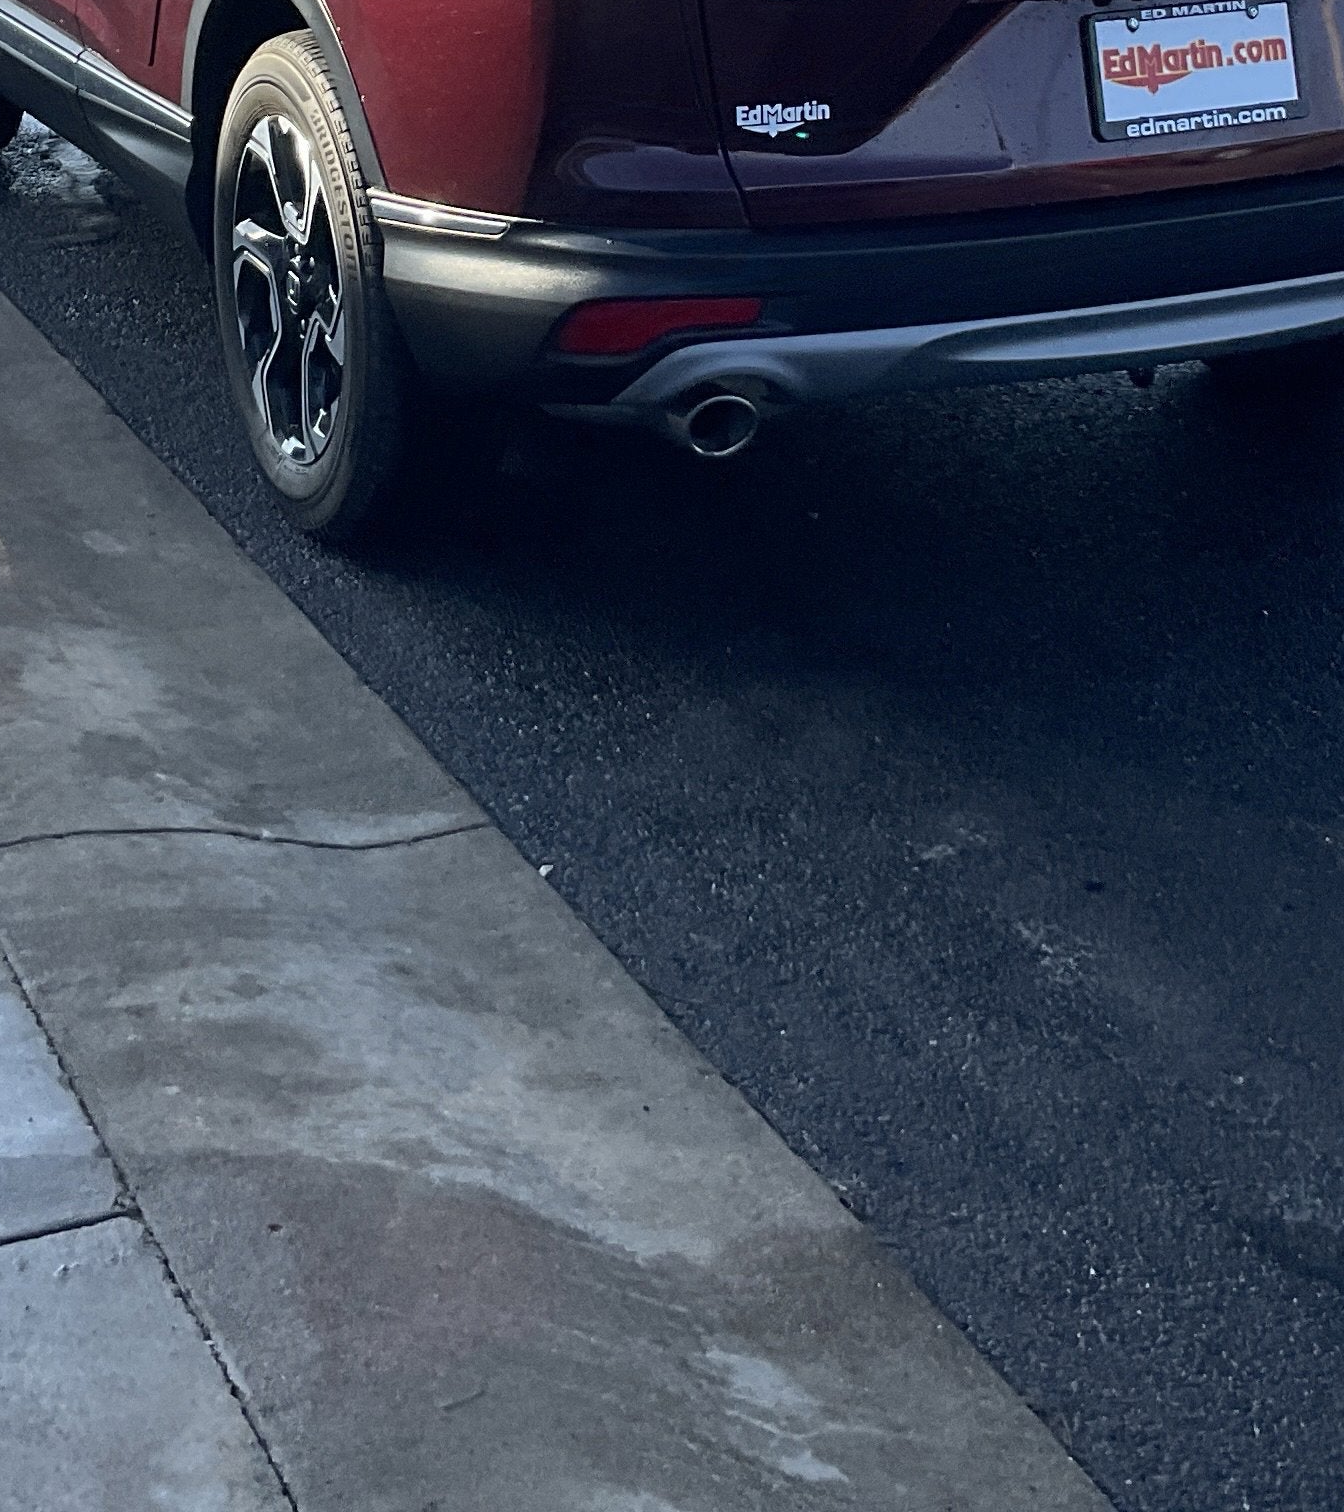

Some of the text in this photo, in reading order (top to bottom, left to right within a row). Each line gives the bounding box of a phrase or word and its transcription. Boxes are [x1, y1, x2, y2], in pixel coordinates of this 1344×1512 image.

[1140, 0, 1247, 20] ED MARTIN
[736, 100, 831, 130] EdMartin
[1126, 105, 1287, 138] edmartin.com
